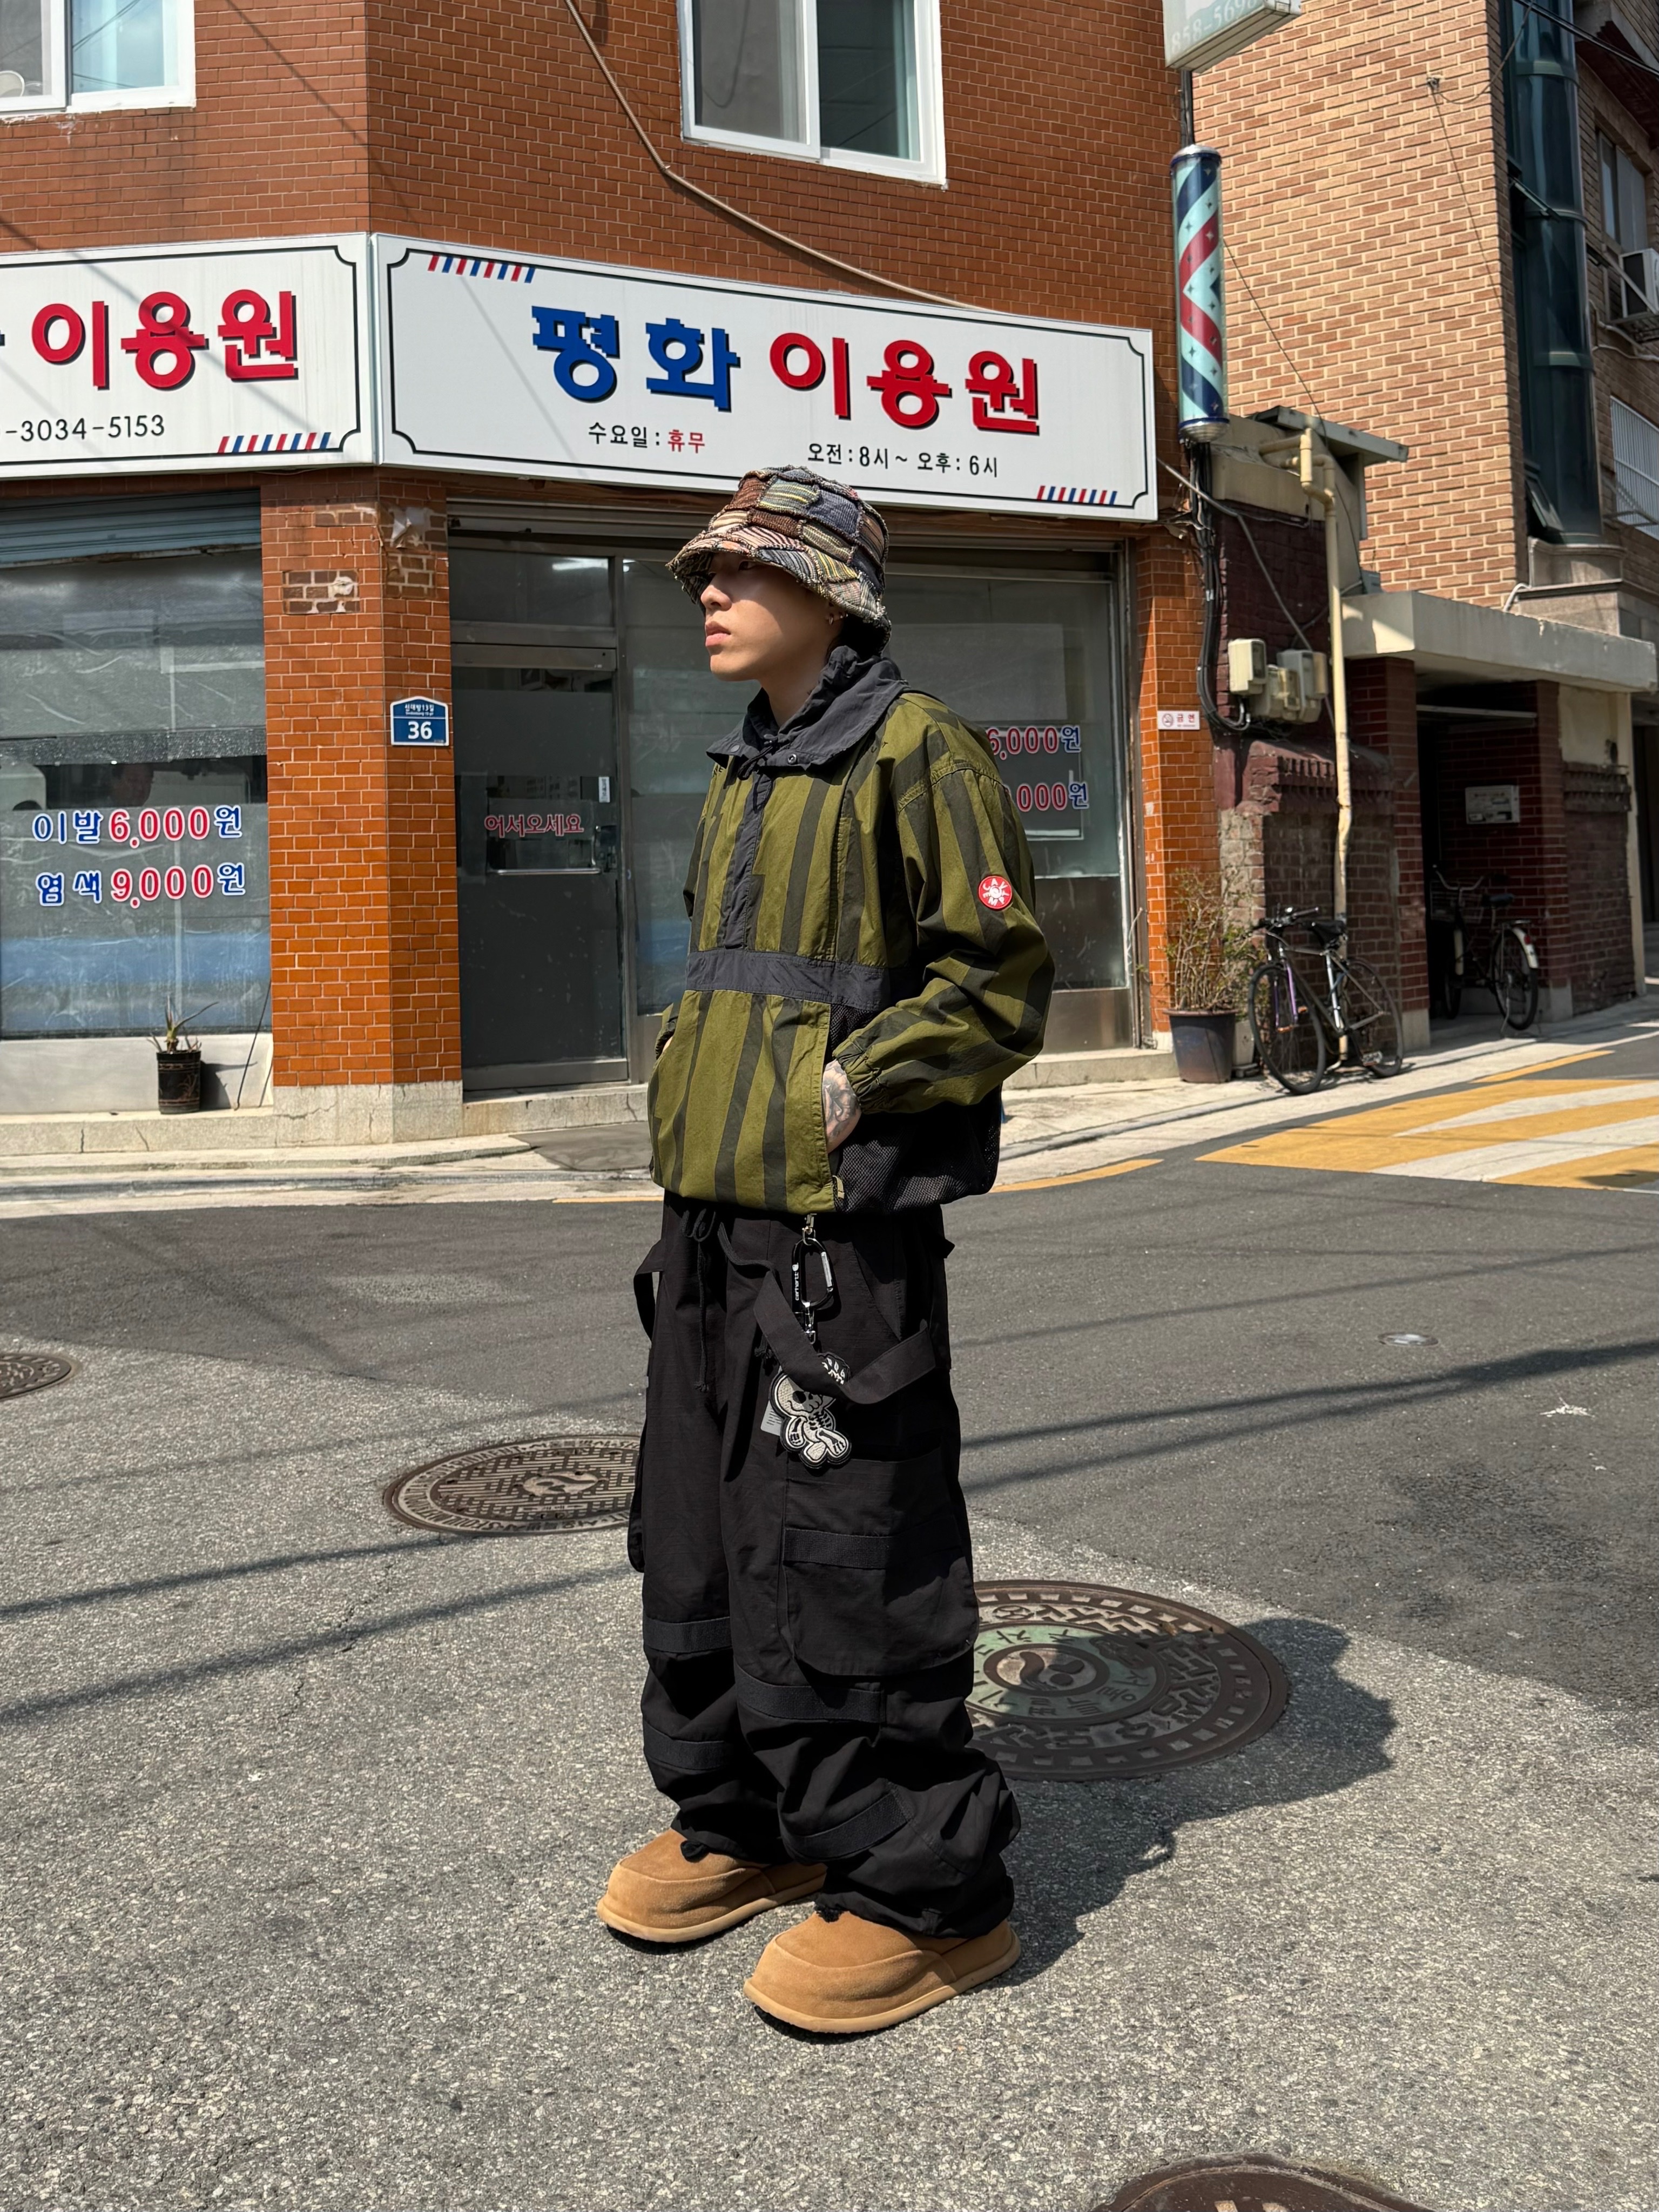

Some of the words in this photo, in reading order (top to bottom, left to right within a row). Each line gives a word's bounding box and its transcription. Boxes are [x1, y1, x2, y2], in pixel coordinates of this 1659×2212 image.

[31, 289, 299, 390] 이용원
[531, 306, 741, 413] 평화
[770, 333, 1040, 436] 이용원
[5, 414, 165, 442] -3034-5153
[408, 721, 433, 740] 36
[32, 810, 104, 845] 이발
[484, 813, 584, 838] 어서오세요
[36, 870, 102, 907] 염색
